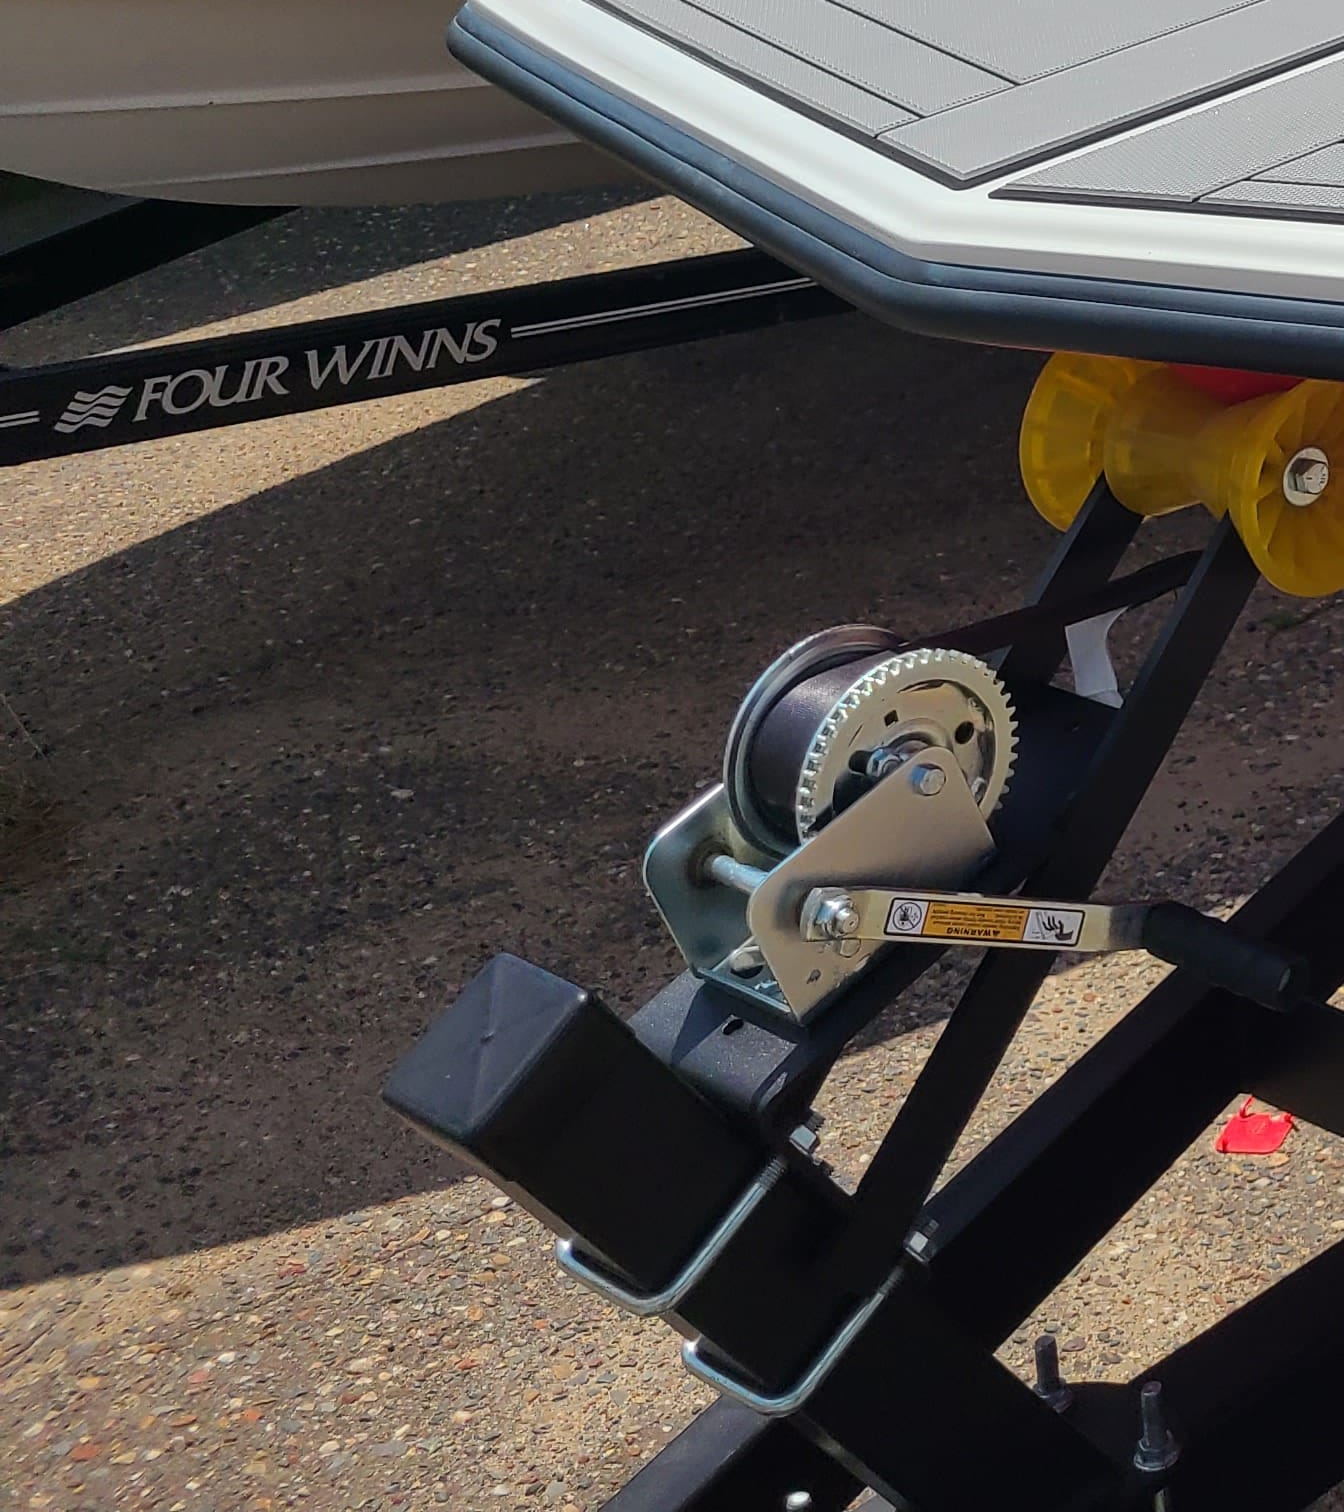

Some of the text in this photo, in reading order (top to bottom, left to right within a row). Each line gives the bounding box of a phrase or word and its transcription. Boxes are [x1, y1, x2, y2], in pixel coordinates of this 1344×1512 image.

[133, 318, 501, 422] FOUR WINNS
[946, 926, 994, 937] WARNING
